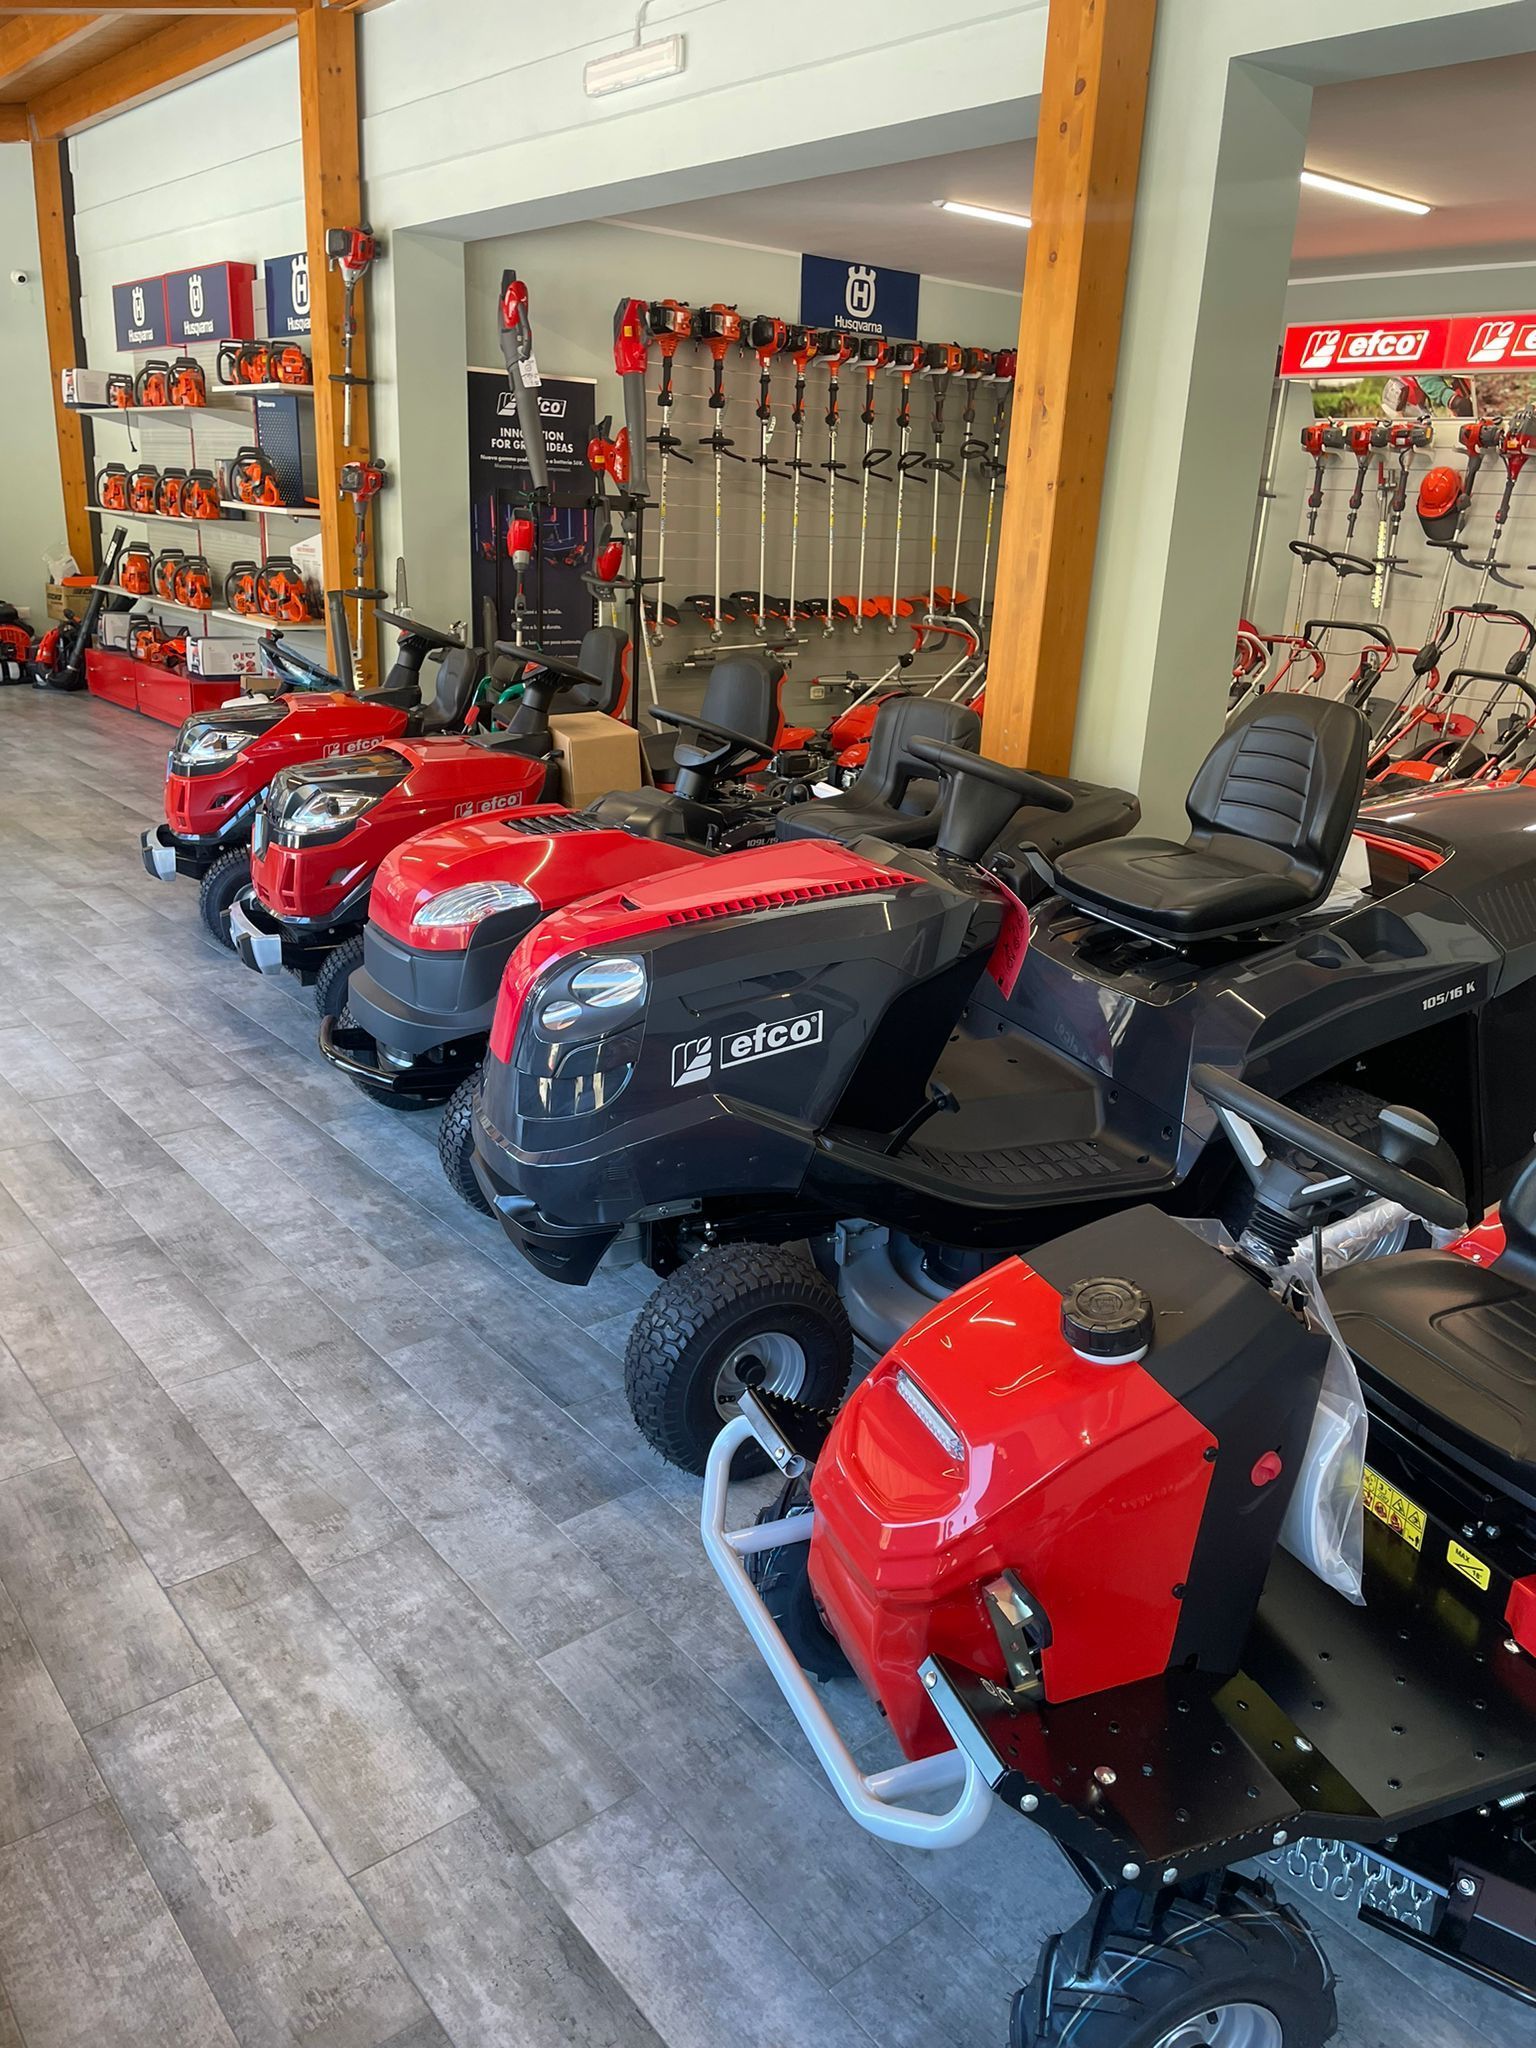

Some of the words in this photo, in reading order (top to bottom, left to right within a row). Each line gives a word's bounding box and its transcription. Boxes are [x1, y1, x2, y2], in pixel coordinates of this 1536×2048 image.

[287, 316, 311, 332] Husqva
[834, 314, 883, 333] Husqvarna
[1348, 329, 1416, 357] efco
[491, 438, 511, 449] FOR
[546, 442, 574, 453] IDEAS
[346, 738, 380, 753] efco
[480, 795, 517, 813] efco
[1422, 985, 1463, 1011] 105/16
[1466, 980, 1476, 994] K
[730, 1019, 812, 1058] efco
[1455, 1548, 1470, 1563] MAX
